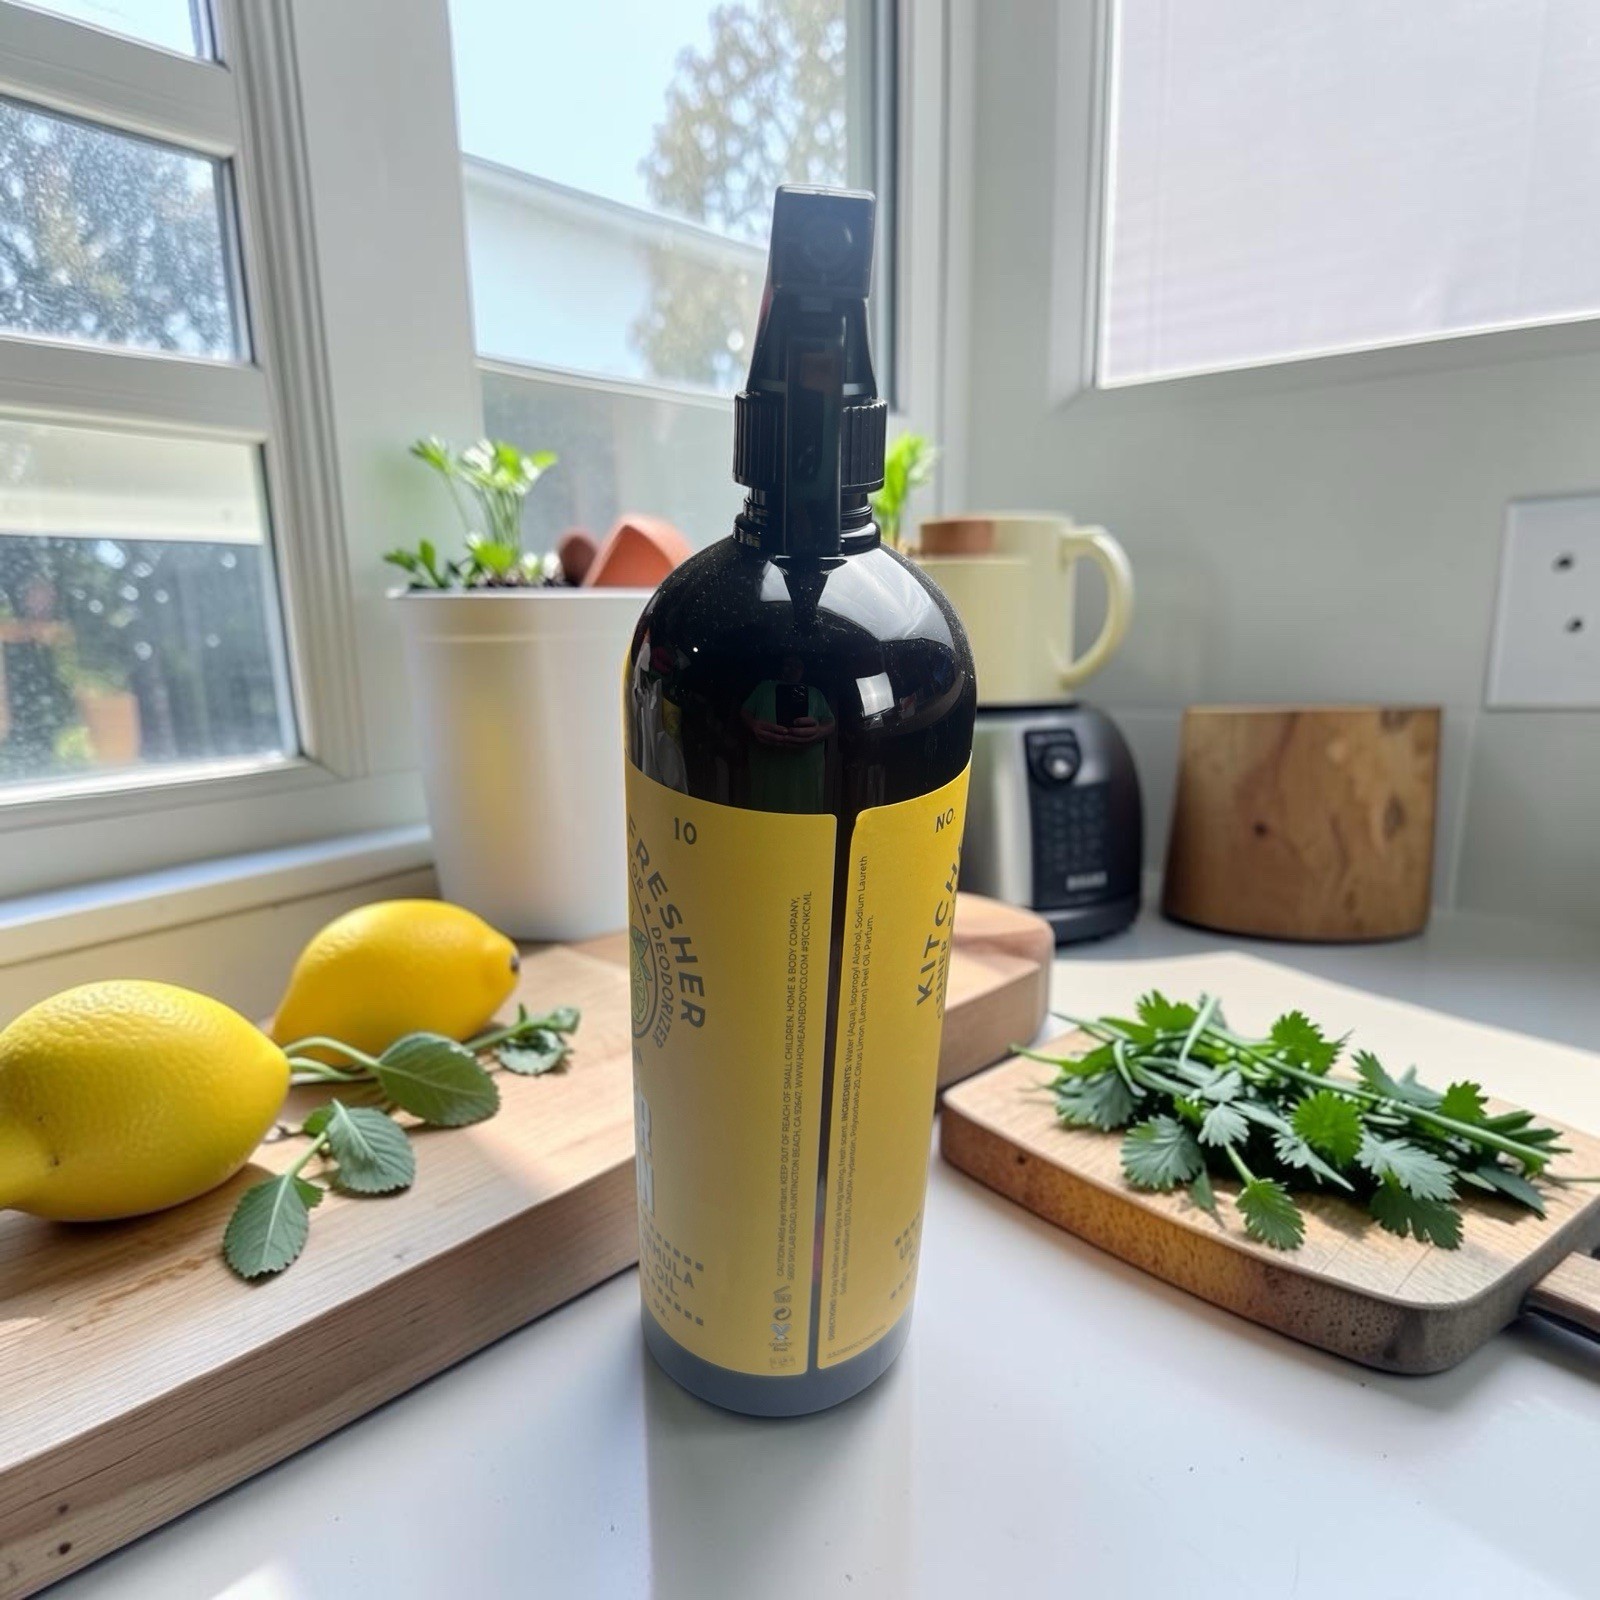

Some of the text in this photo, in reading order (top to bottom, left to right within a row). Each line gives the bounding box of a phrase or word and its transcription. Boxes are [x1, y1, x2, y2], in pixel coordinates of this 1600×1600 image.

[935, 807, 956, 833] NO.
[858, 855, 868, 892] Laureth
[790, 897, 800, 946] COMPANY,
[855, 894, 865, 928] Sodium
[865, 915, 874, 950] Parfum.
[789, 948, 797, 974] BODY
[853, 930, 862, 965] Alcohol,
[863, 951, 871, 966] Oil,
[650, 926, 675, 1049] DEODORIZER
[787, 984, 795, 1012] HOME
[850, 967, 860, 1006] Isopropyl
[795, 954, 809, 1088] WWW.HOMEANDBODYCO.COM
[785, 1014, 795, 1060] CHILDREN.
[846, 1039, 854, 1063] Water
[857, 1025, 865, 1051] Limon
[784, 1062, 793, 1090] SMALL
[855, 1052, 863, 1077] Citrus
[784, 1091, 791, 1102] OF
[842, 1064, 851, 1122] INGREDIENTS:
[783, 1105, 791, 1132] REACH
[794, 1116, 801, 1127] CA
[782, 1133, 790, 1145] OF
[792, 1129, 802, 1158] BEACH,
[781, 1148, 789, 1163] OUT
[780, 1164, 788, 1184] KEEP
[790, 1160, 799, 1210] HUNTINGTON
[780, 1213, 788, 1226] eye
[655, 1263, 679, 1297] OIL
